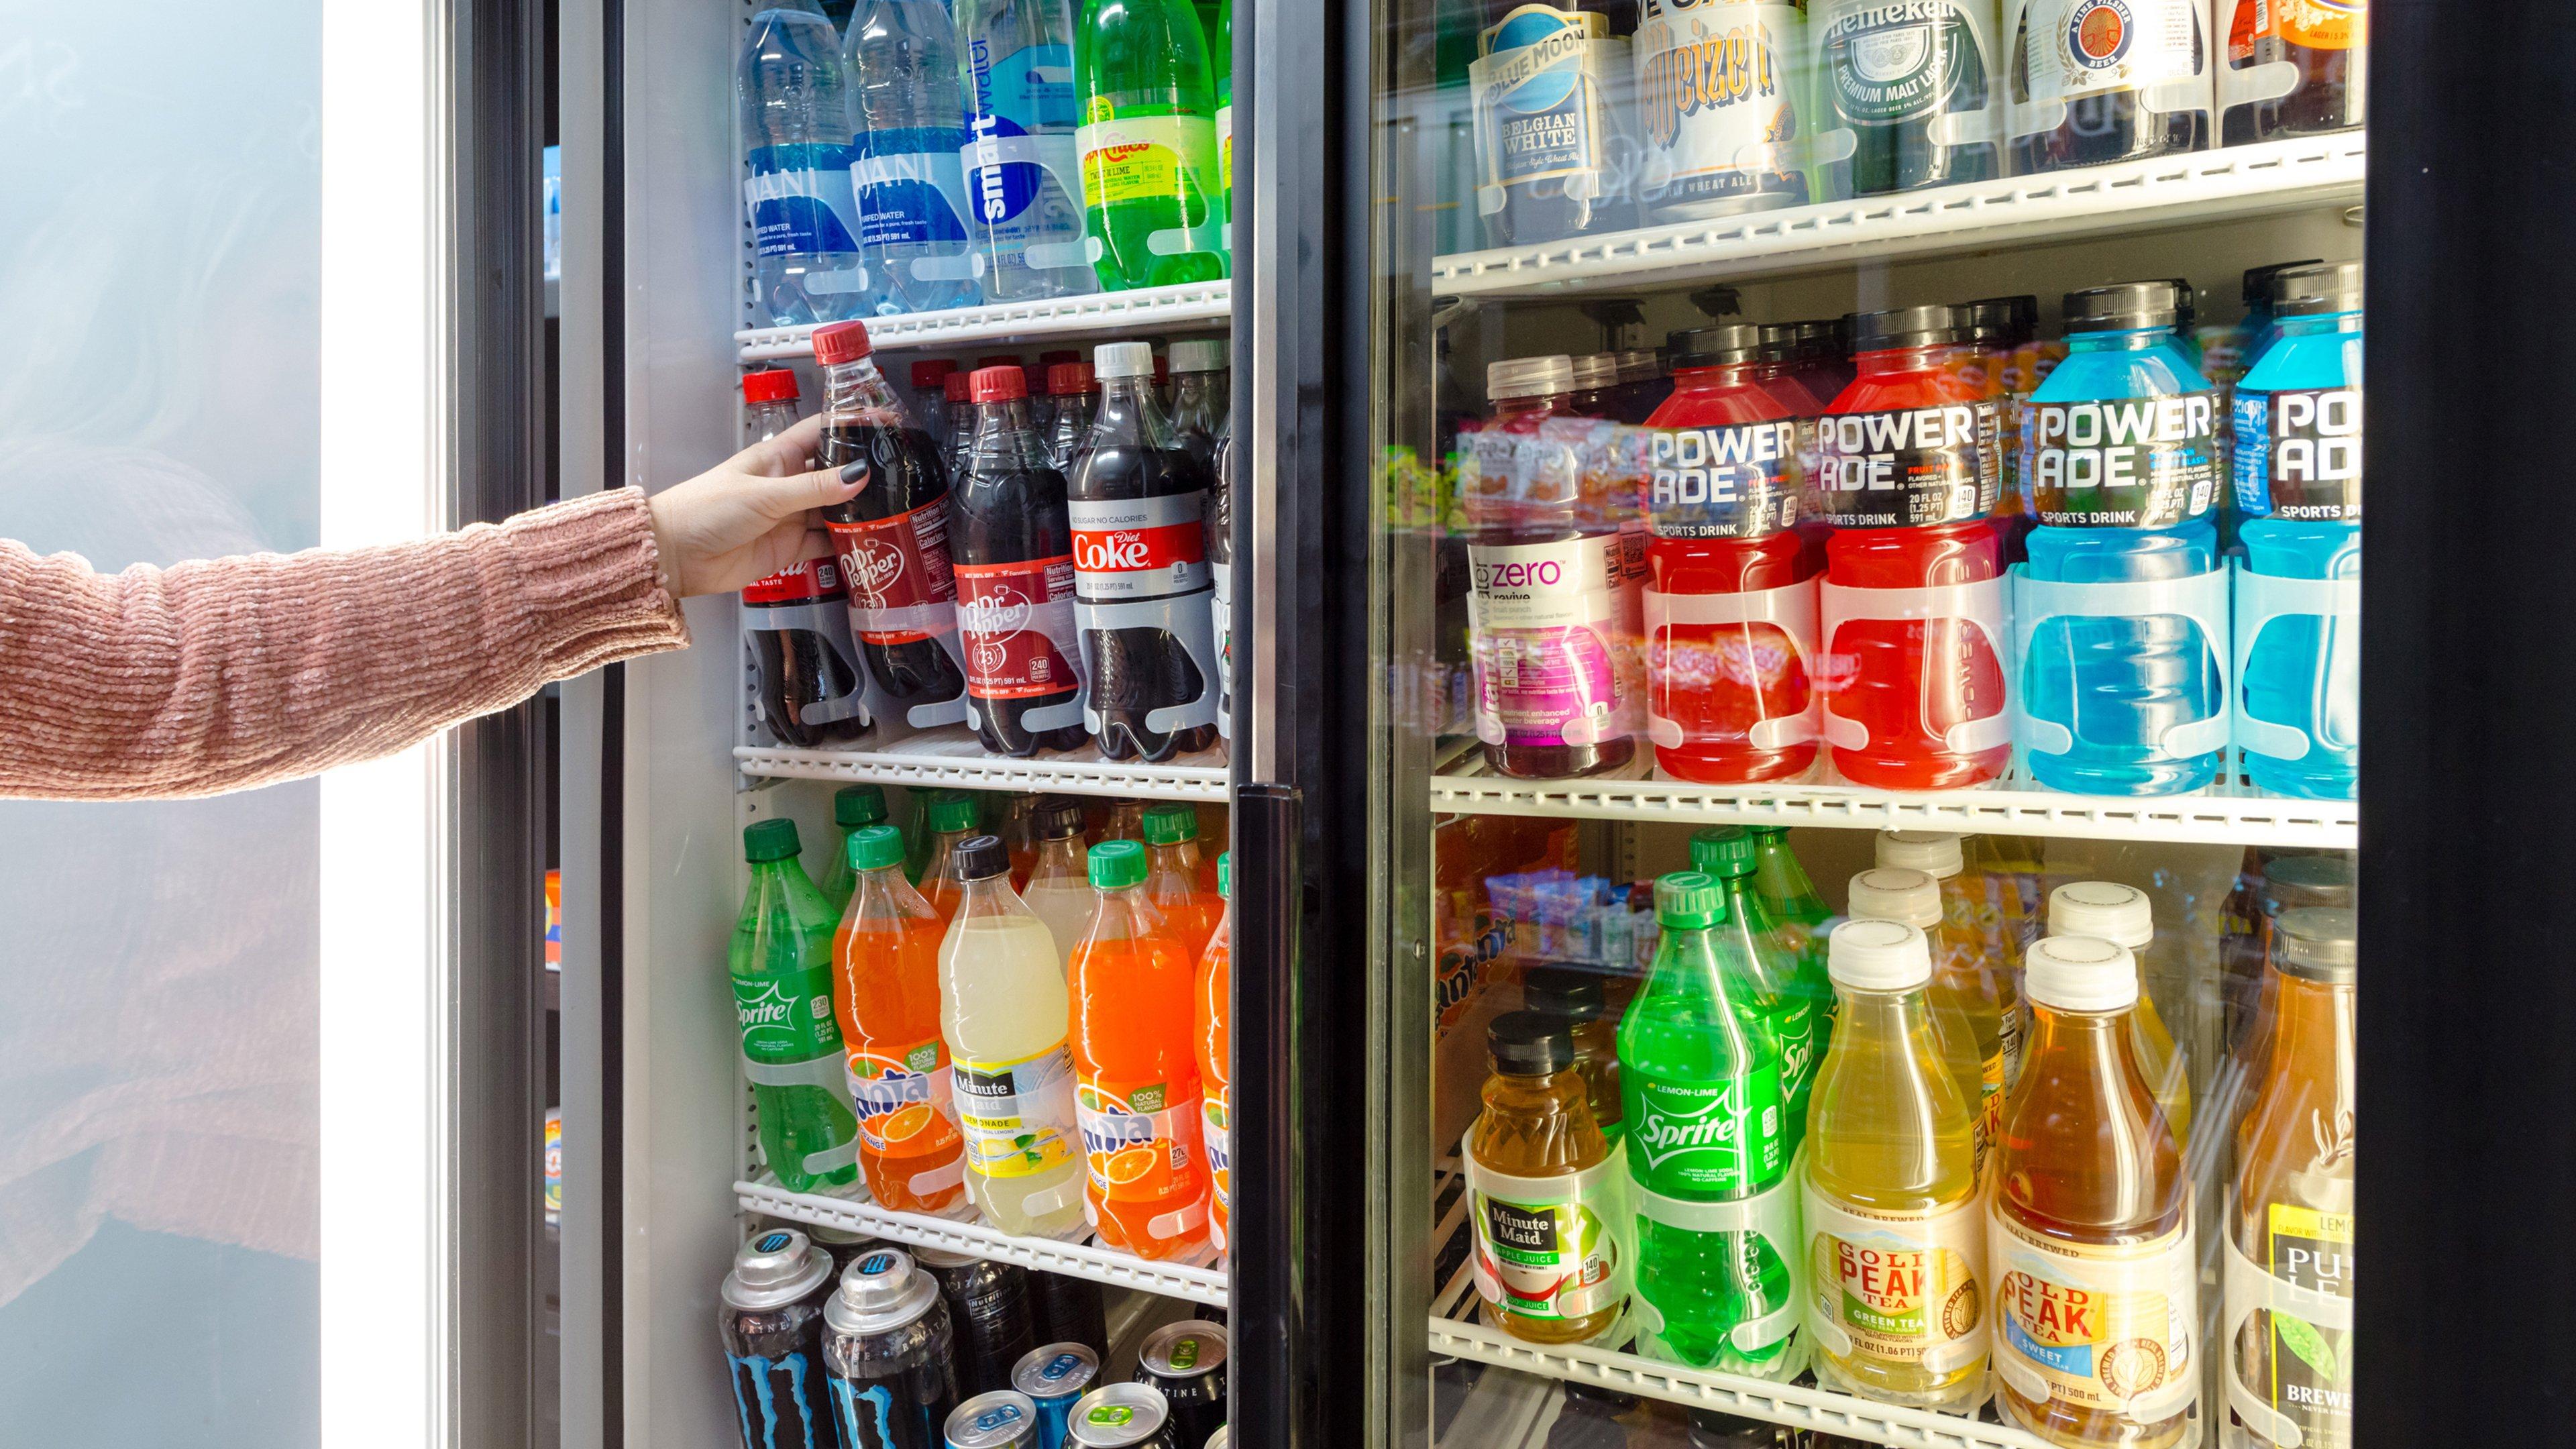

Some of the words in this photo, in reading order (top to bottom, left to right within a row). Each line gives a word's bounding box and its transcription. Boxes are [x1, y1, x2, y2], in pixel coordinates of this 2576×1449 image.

[1828, 0, 1956, 39] Heineken
[2076, 2, 2094, 25] FINE
[2096, 0, 2133, 24] PILSNER
[2309, 30, 2329, 40] LAGER
[1487, 55, 1531, 89] BLUE
[1532, 29, 1586, 70] MOON
[2088, 55, 2118, 68] BEER
[1838, 63, 1881, 103] PREMIUM
[1886, 79, 1919, 103] MALT
[1502, 113, 1576, 136] BELGIAN
[1504, 127, 1576, 155] WHITE
[1545, 153, 1568, 164] Wheat
[1568, 151, 1580, 161] Ale
[1113, 166, 1130, 175] LIME
[1688, 177, 1726, 193] WHEAT
[1731, 174, 1752, 187] ALE
[879, 211, 905, 220] WATER
[768, 223, 791, 233] WATER
[2278, 391, 2362, 437] PO
[2040, 396, 2210, 447] POWER
[1819, 406, 1974, 453] POWER
[1652, 421, 1795, 468] POWER
[2277, 437, 2362, 481] AD
[1821, 453, 1896, 491] ADE
[1908, 466, 1933, 475] FRUIT
[2038, 445, 2136, 488] ADE
[1654, 466, 1737, 504] ADE
[1908, 475, 1938, 483] FLAVORED
[1910, 494, 1919, 503] 20
[1921, 493, 1931, 502] FL
[1933, 492, 1943, 502] OZ
[1957, 488, 1972, 502] 140
[2176, 488, 2184, 498] OZ
[2194, 484, 2209, 499] 140
[1768, 502, 1776, 511] OZ
[1786, 498, 1797, 513] 140
[1910, 503, 1929, 513] (1.25
[1930, 502, 1943, 512] PT)
[2280, 505, 2341, 519] SPORTS
[912, 505, 940, 523] Nutrition
[1077, 516, 1096, 524] SUGAR
[1096, 516, 1108, 524] NO
[1109, 514, 1148, 523] CALORIES
[1825, 513, 1856, 526] SPORTS
[1859, 513, 1897, 525] DRINK
[1910, 513, 1923, 523] 591
[1925, 513, 1937, 522] mL
[2041, 511, 2086, 524] SPORTS
[2090, 510, 2136, 523] DRINK
[876, 521, 898, 530] Fanatics
[914, 519, 932, 531] Serving
[1658, 525, 1696, 536] SPORTS
[1699, 523, 1737, 536] DRINK
[918, 532, 945, 550] Calories
[1114, 531, 1140, 543] Diet
[851, 548, 876, 570] Dr
[1075, 534, 1150, 570] Coke
[819, 566, 833, 577] 240
[841, 552, 897, 590] Pepper
[1046, 564, 1074, 576] Nutrition
[1177, 563, 1183, 574] 0
[1491, 561, 1561, 588] zero
[1047, 575, 1065, 583] Serving
[1049, 590, 1074, 602] Calories
[913, 602, 928, 615] 240
[978, 594, 1005, 616] Dr
[1509, 606, 1532, 615] punch
[965, 600, 1026, 641] Pepper
[979, 651, 993, 665] 23
[1031, 658, 1049, 669] 240
[1004, 677, 1014, 685] 591
[1016, 676, 1026, 684] mL
[1503, 709, 1530, 717] nutrient
[1530, 708, 1570, 717] enhanced
[1523, 716, 1560, 726] beverage
[736, 979, 770, 987] LEMON-LIME
[812, 997, 827, 1009] 230
[736, 1000, 786, 1026] Sprite
[814, 1029, 827, 1038] (1.25
[908, 1049, 935, 1061] 100%
[911, 1056, 935, 1066] NATURAL
[913, 1061, 935, 1071] FLAVORS
[957, 1075, 1008, 1095] Minute
[1656, 1084, 1718, 1097] LEMON-LIME
[1132, 1089, 1162, 1102] 100%
[964, 1095, 1002, 1111] Maid
[1134, 1099, 1162, 1108] NATURAL
[1137, 1104, 1162, 1112] FLAVORS
[965, 1117, 1010, 1128] LEMONADE
[1764, 1108, 1776, 1124] 230
[860, 1127, 885, 1150] ORANGE
[1643, 1114, 1735, 1150] Sprite
[1493, 1207, 1549, 1231] Minute
[1500, 1224, 1542, 1246] Maid
[2278, 1224, 2302, 1235] FLAVOR
[2006, 1222, 2028, 1242] REAL
[2028, 1235, 2080, 1258] BREWED
[1495, 1246, 1521, 1260] APPLE
[1523, 1253, 1552, 1263] JUICE
[1585, 1257, 1598, 1272] 140
[971, 1287, 1012, 1307] Nutrition
[1863, 1293, 1909, 1308] TEA
[1951, 1288, 1963, 1301] TEA
[1524, 1301, 1547, 1309] JUICE
[2004, 1275, 2092, 1338] PEAK
[1854, 1309, 1896, 1328] GREEN
[1899, 1318, 1925, 1328] TEA
[1872, 1331, 1900, 1339] FLAVORED
[2019, 1315, 2061, 1343] TEA
[1854, 1338, 1864, 1347] FL
[1864, 1340, 1875, 1351] OZ
[1876, 1344, 1898, 1356] (1.06
[1900, 1347, 1915, 1357] PT)
[2021, 1338, 2063, 1363] SWEET
[2048, 1358, 2070, 1372] SUGAR
[2051, 1381, 2066, 1395] PT)
[2068, 1387, 2085, 1399] 500
[2087, 1390, 2102, 1403] mL
[2302, 1404, 2329, 1415] NEVER
